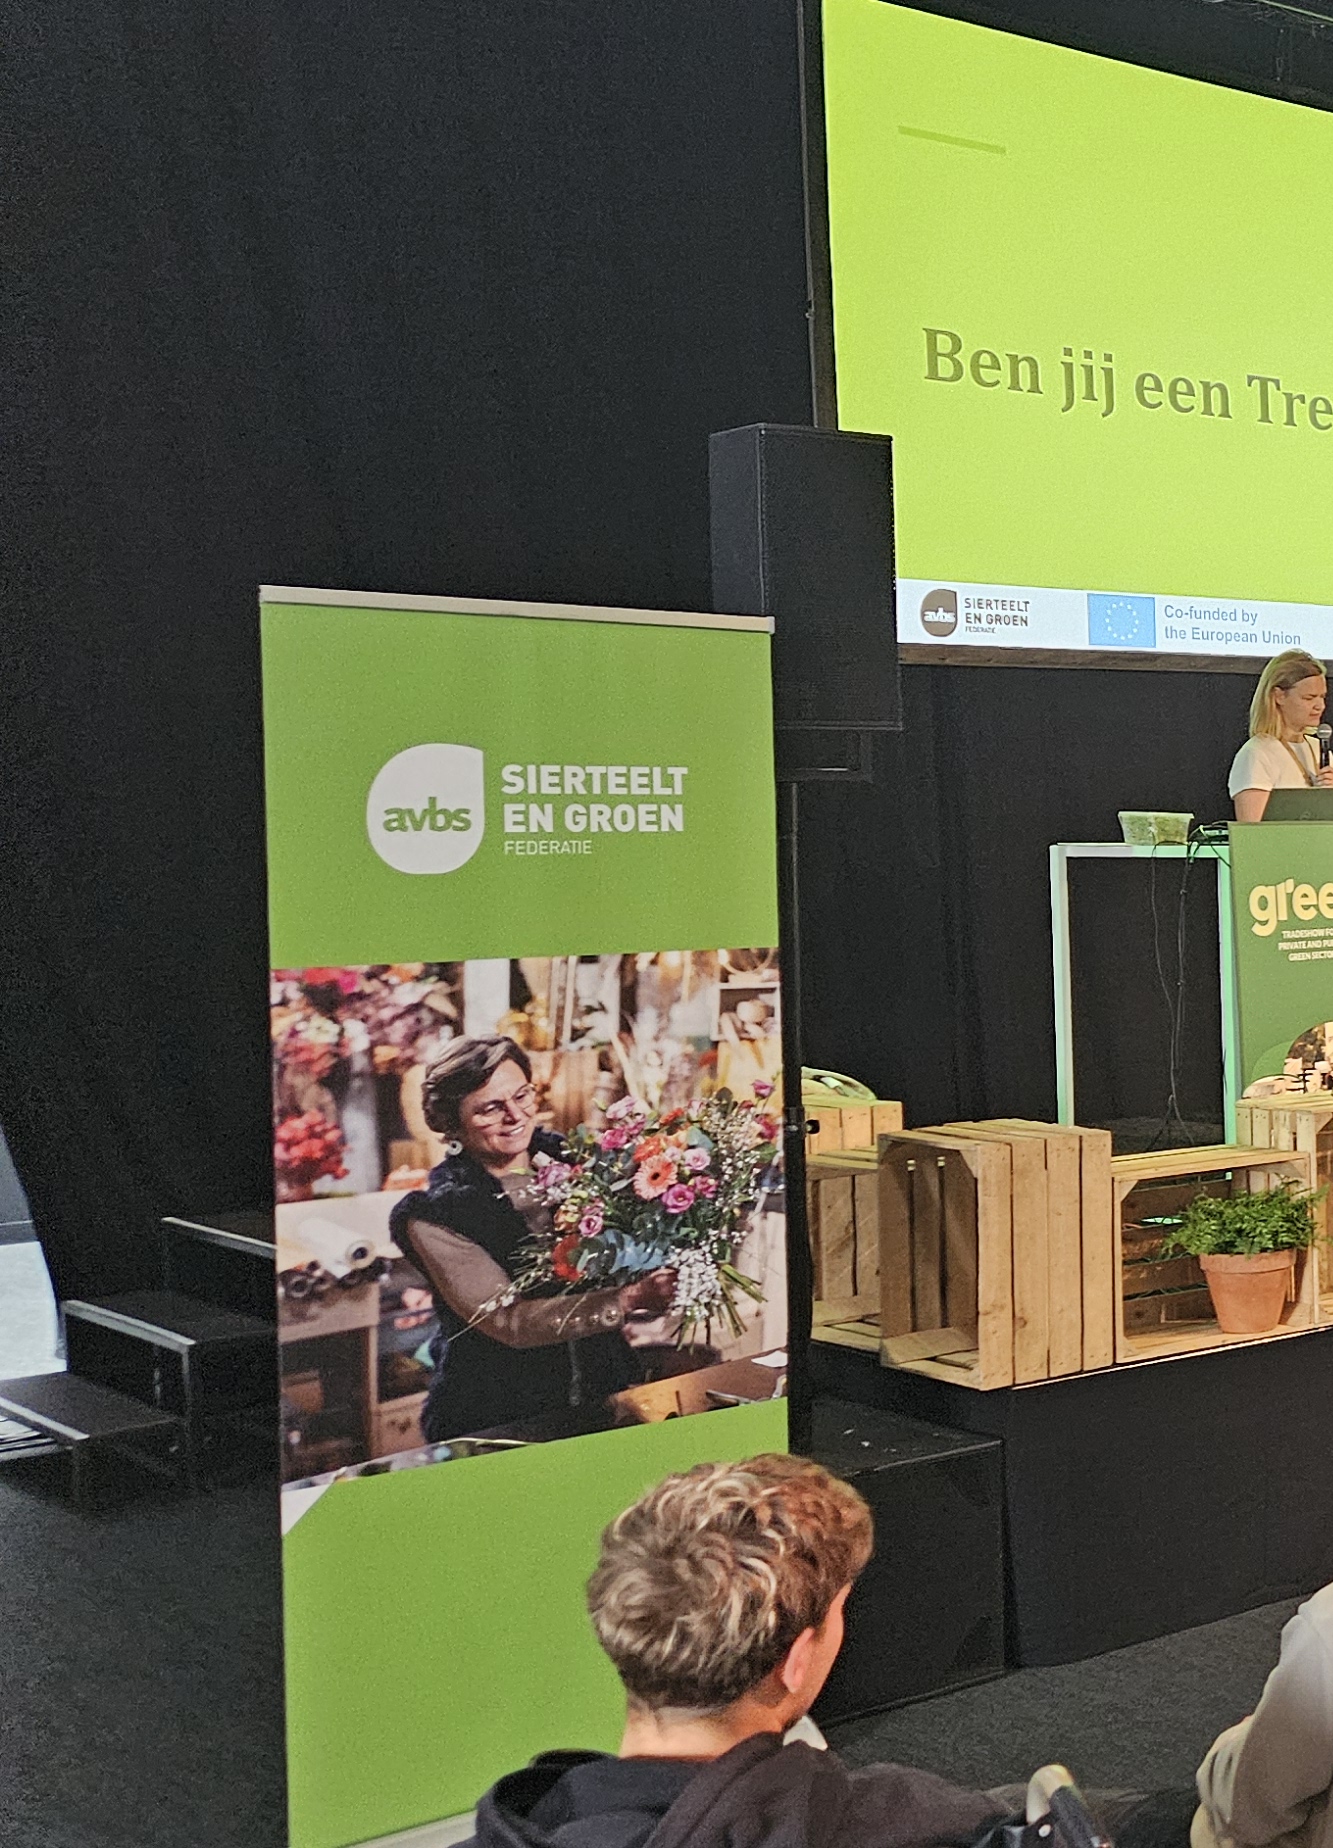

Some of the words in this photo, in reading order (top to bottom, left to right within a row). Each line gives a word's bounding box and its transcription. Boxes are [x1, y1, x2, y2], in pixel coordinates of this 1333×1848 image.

[922, 327, 1043, 394] Ben
[1060, 347, 1114, 418] jij
[1135, 371, 1232, 420] een
[964, 597, 1030, 612] SIERTEELT
[965, 612, 982, 624] EN
[985, 614, 1028, 627] GROEN
[1164, 604, 1237, 622] Co-funded
[1241, 608, 1258, 626] by
[1164, 626, 1187, 640] the
[1191, 627, 1258, 645] European
[1262, 630, 1301, 645] Union
[501, 764, 688, 796] SIERTEELT
[383, 796, 472, 832] avbs
[503, 803, 553, 833] EN
[564, 803, 684, 833] GROEN
[504, 840, 592, 856] FEDERATIE
[1281, 928, 1326, 939] TRADESHOW
[1278, 940, 1307, 951] PRIVATE
[1307, 940, 1322, 949] AND
[1288, 952, 1311, 962] GREEN
